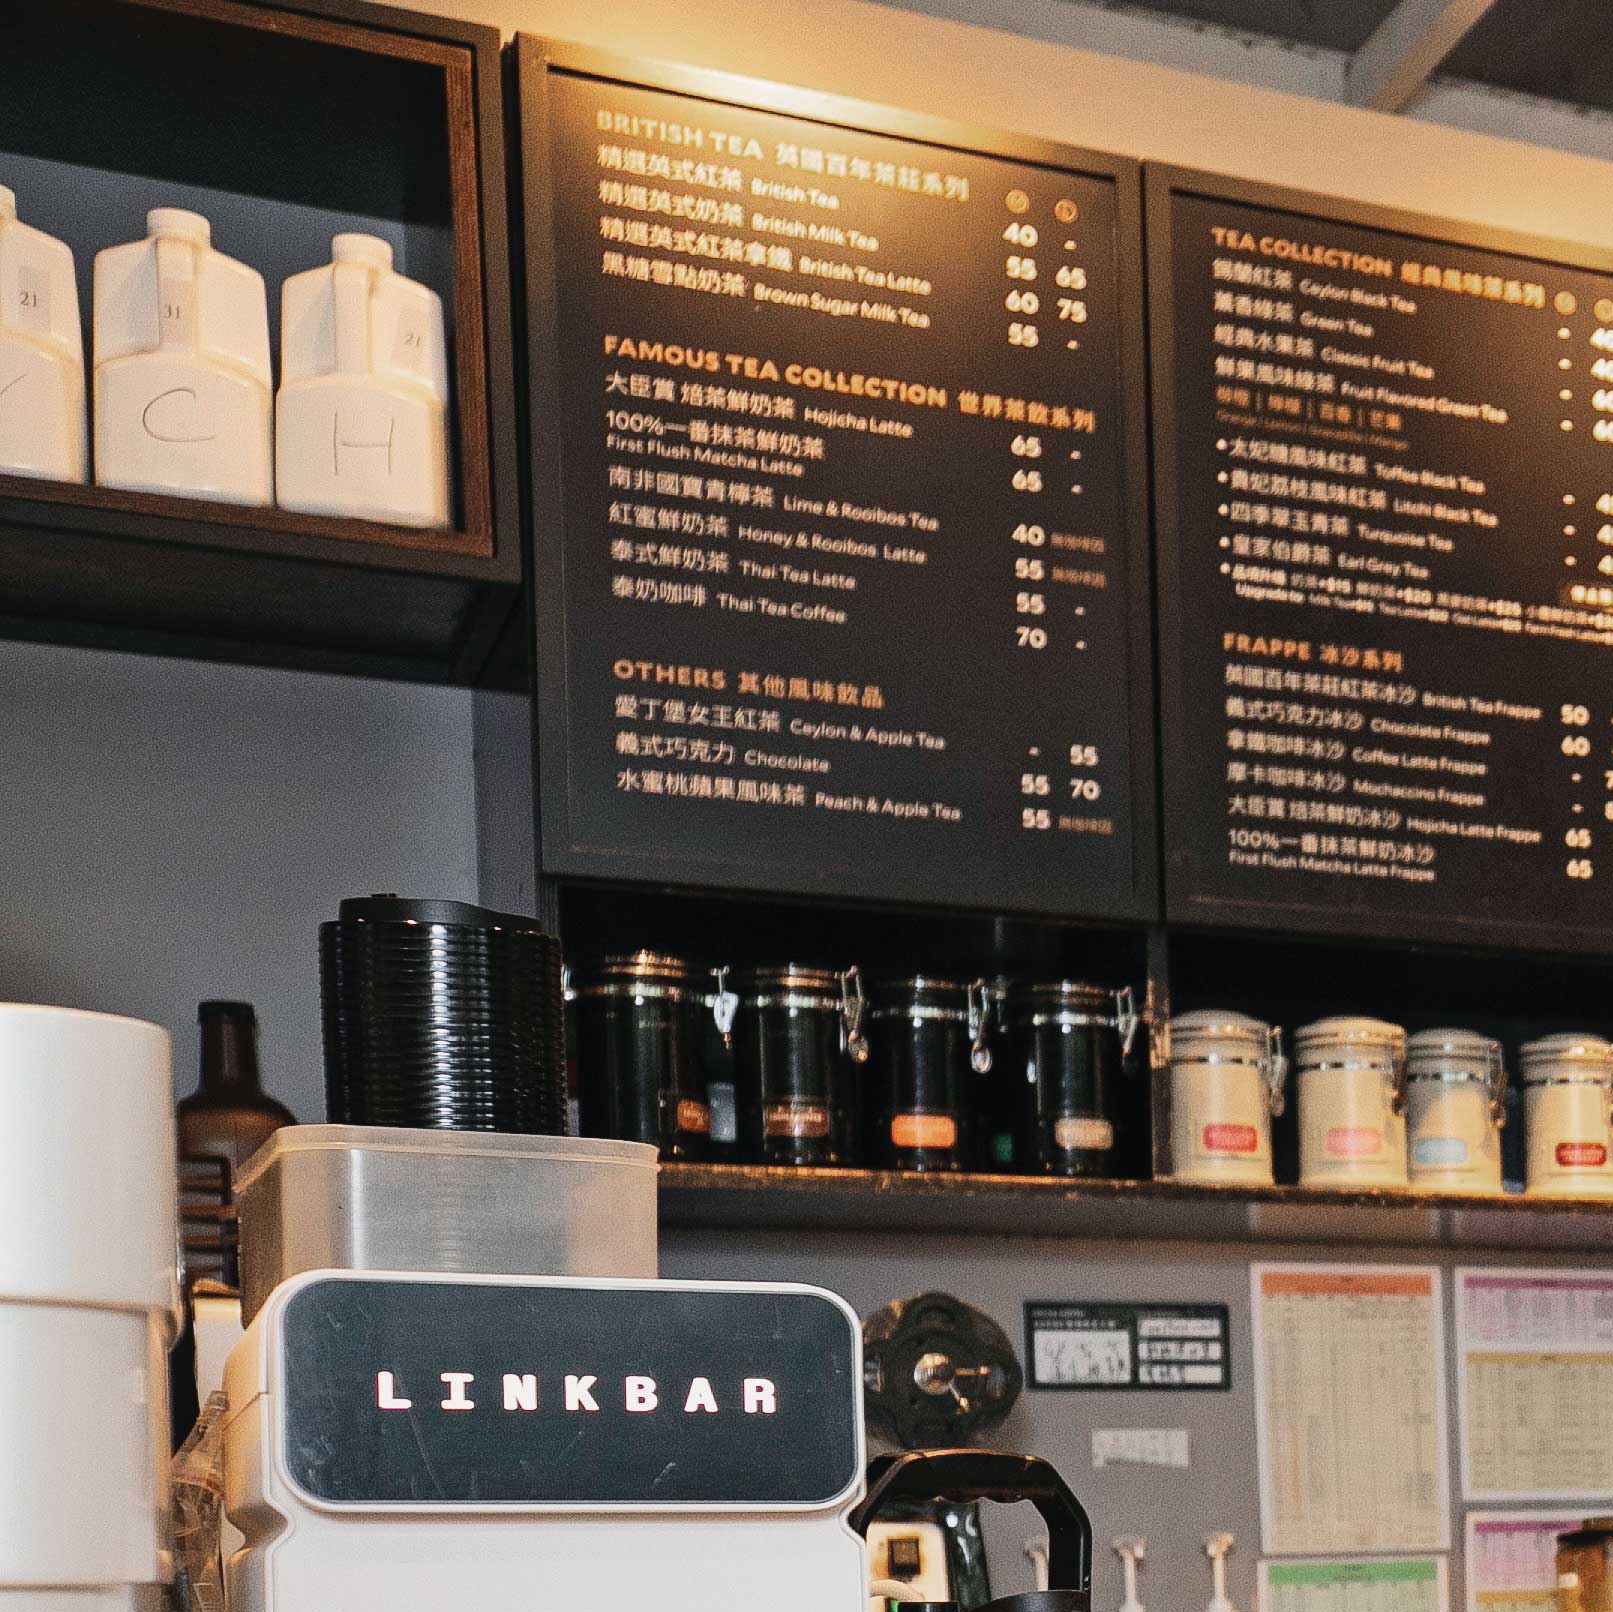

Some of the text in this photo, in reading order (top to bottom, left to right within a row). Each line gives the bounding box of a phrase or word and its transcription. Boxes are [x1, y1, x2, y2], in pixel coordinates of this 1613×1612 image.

[597, 111, 765, 159] BRITISH TEA
[752, 176, 807, 202] British
[807, 182, 839, 210] Tea
[1003, 222, 1038, 247] 40
[752, 213, 809, 238] British
[808, 223, 848, 245] Milk
[846, 229, 878, 251] Tea
[1006, 255, 1037, 280] 55
[1056, 266, 1086, 289] 65
[1211, 227, 1393, 277] TEA COLLECTION
[799, 256, 858, 281] British
[856, 265, 887, 286] Tea
[885, 272, 931, 295] Latte
[1005, 290, 1039, 314] 60
[1057, 298, 1087, 323] 75
[754, 283, 1039, 347] Brown Milk Tea 55
[605, 336, 720, 372] FAMOUS
[725, 354, 779, 381] TEA
[785, 364, 946, 407] COLLECTION
[333, 412, 395, 477] H
[607, 434, 803, 476] First Flush Matcha Latte
[804, 407, 870, 431] Hojicha
[869, 417, 913, 438] Latte
[1011, 435, 1041, 457] 65
[1012, 470, 1042, 492] 65
[784, 495, 824, 515] Lime
[841, 503, 907, 526] Rooibos
[908, 512, 939, 531] Tea
[1012, 524, 1045, 546] 40
[738, 526, 1044, 580] Honey Rooibos Latte 55
[739, 560, 777, 579] Thai
[780, 565, 810, 584] Tea
[813, 570, 856, 590] Latte
[1016, 592, 1045, 614] 55
[717, 593, 753, 612] Thai
[757, 598, 790, 616] Tea
[788, 603, 846, 624] Coffee
[1016, 626, 1047, 649] 70
[1224, 633, 1309, 660] FRAPPE
[613, 660, 725, 689] OTHERS
[790, 719, 847, 739] Ceylon
[865, 727, 913, 746] Apple
[916, 732, 945, 750] Tea
[1070, 745, 1098, 766] 55
[744, 750, 1100, 800] Chocolate 55 70
[815, 792, 864, 810] Peach
[881, 799, 929, 817] Apple
[932, 803, 961, 820] Tea
[1023, 808, 1051, 829] 55
[375, 1370, 778, 1415] LINKBAR
